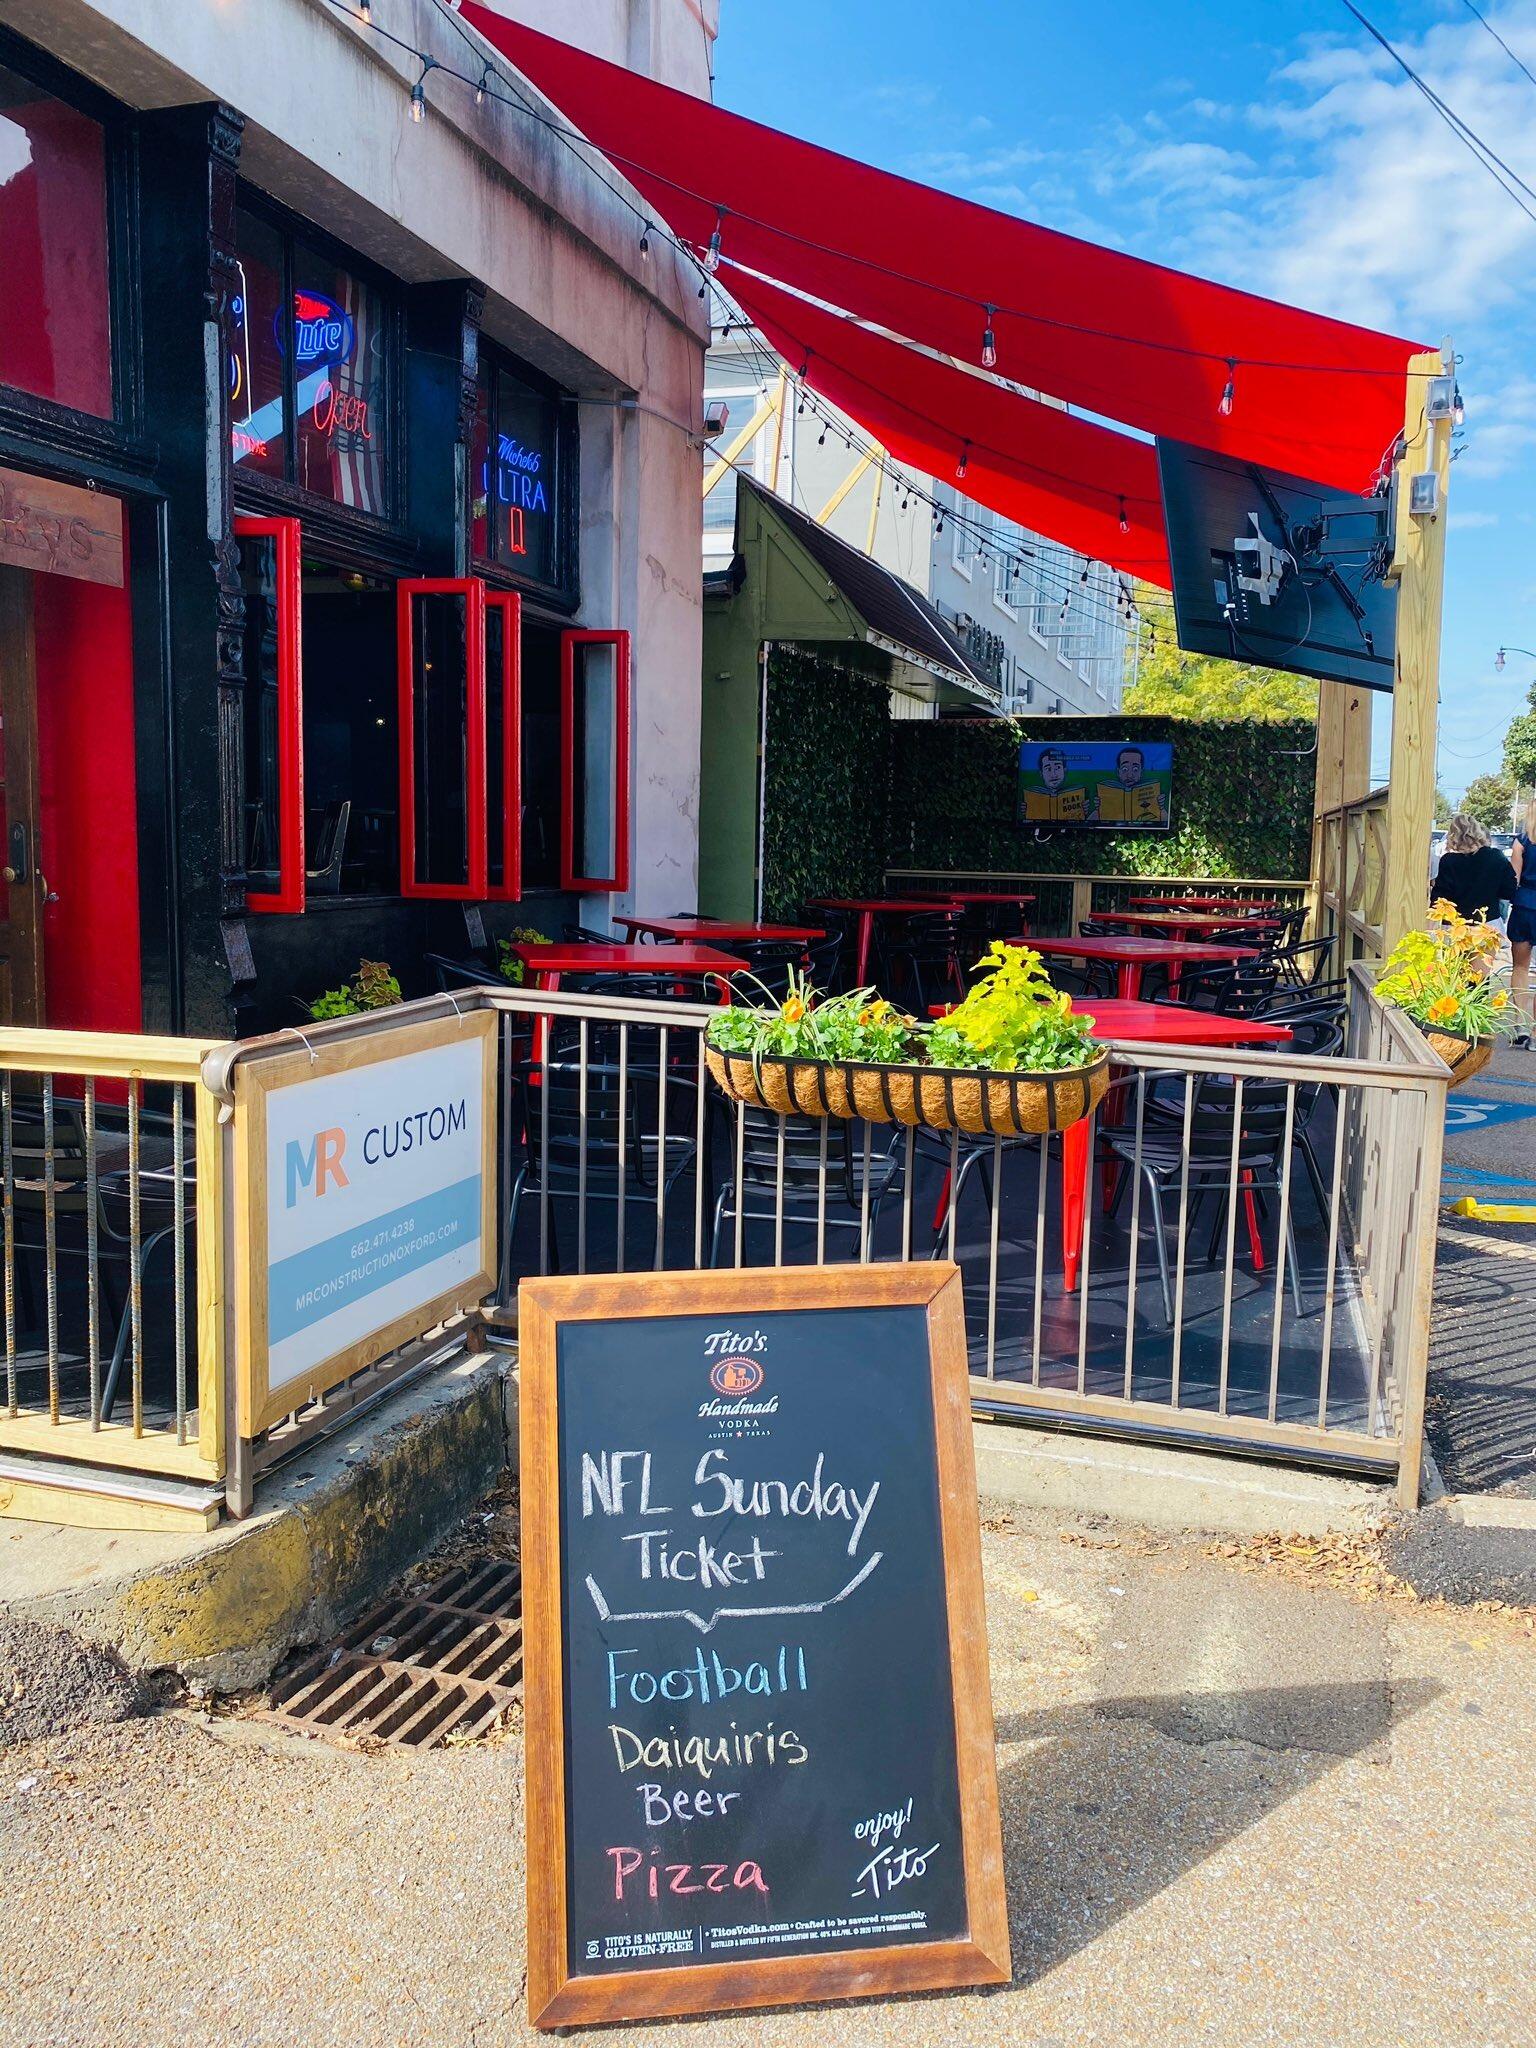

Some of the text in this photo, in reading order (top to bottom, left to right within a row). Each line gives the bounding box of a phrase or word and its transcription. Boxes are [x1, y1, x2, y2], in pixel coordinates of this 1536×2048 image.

[314, 381, 371, 439] Open
[286, 1099, 466, 1209] MR CUSTOM
[350, 1218, 415, 1259] 662.471.4238
[295, 1221, 459, 1312] MRCONSTRUCTIONOXFORD.COM
[698, 1395, 779, 1417] Handmade
[719, 1419, 759, 1429] VODKA
[582, 1449, 880, 1557] NFL Sunday
[621, 1529, 784, 1589] Ticket
[606, 1646, 809, 1709] Football
[607, 1721, 810, 1779] Daiquiris
[636, 1783, 741, 1826] Beer
[854, 1797, 913, 1848] enjoy!
[606, 1846, 770, 1901] Pizza
[605, 1929, 693, 1947] TITO'S IS NATURALLY
[711, 1910, 927, 1938] TitosVodka.com Crafted to be savored responsibly.
[711, 1939, 734, 1949] DISTILLED
[740, 1937, 759, 1946] BOTTLED
[767, 1935, 780, 1943] FIFTH
[605, 1941, 694, 1959] GLUTEN-FREE
